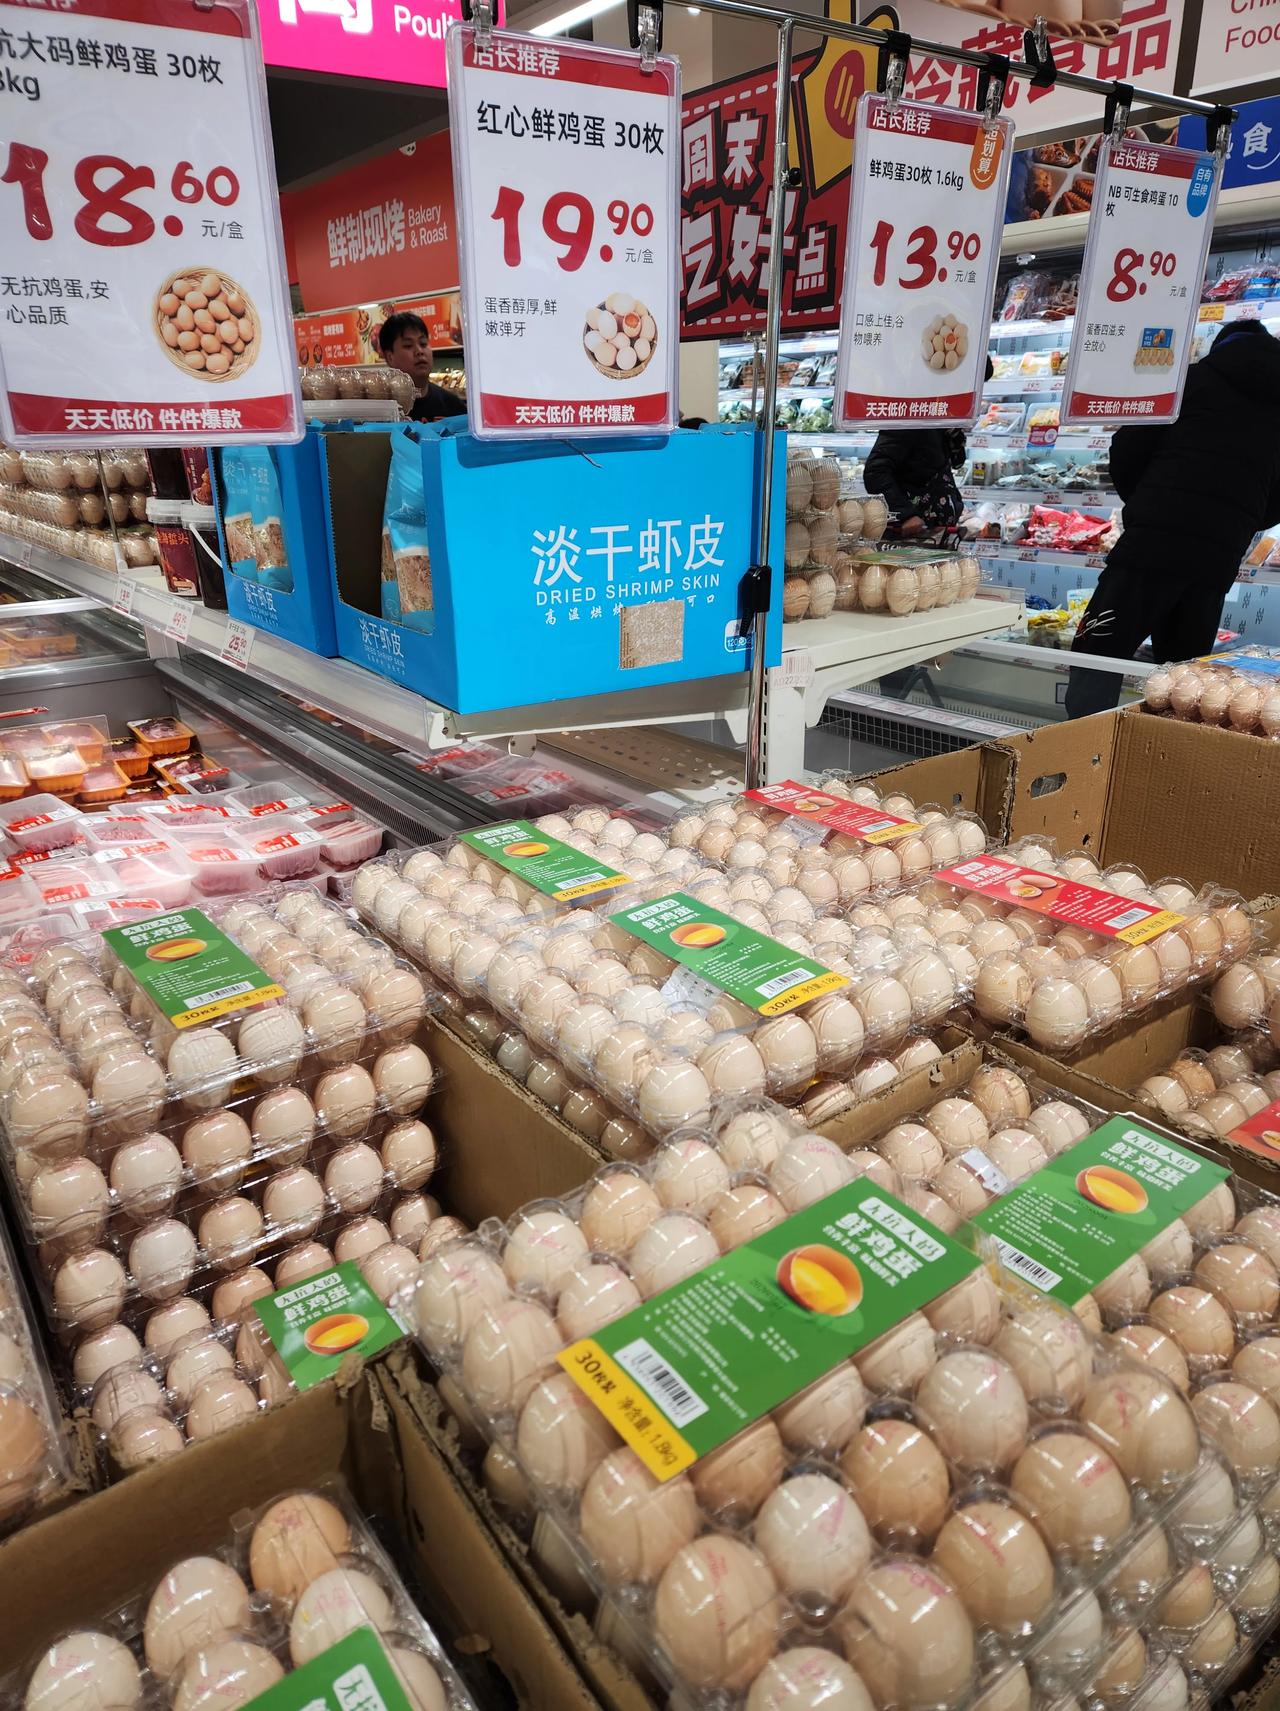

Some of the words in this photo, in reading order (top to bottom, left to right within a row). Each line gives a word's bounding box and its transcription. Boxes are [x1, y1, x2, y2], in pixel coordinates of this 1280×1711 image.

[167, 53, 224, 85] 30枚
[472, 42, 561, 77] 店长推荐
[476, 99, 607, 149] 红心鲜鸡蛋
[613, 123, 665, 155] 30枚
[872, 104, 932, 135] 店长推荐
[682, 112, 761, 193] 周末
[1112, 148, 1160, 171] 店长推荐
[869, 159, 932, 186] 鲜鸡蛋30枚
[936, 168, 964, 191] 1.6kg
[1108, 185, 1121, 198] NB
[1124, 185, 1167, 206] 可生食鸡蛋
[1168, 193, 1179, 207] 10
[408, 204, 442, 227] Bakery
[1105, 201, 1116, 217] 枚
[200, 219, 245, 240] 元/盒
[325, 198, 406, 269] 鲜制现烤
[410, 234, 418, 248] &
[419, 223, 449, 246] Roast
[625, 247, 655, 265] 元/盒
[955, 269, 977, 284] 元/盒
[6, 304, 69, 326] 心品质
[484, 321, 526, 339] 嫩弹牙
[853, 331, 882, 347] 物喂养
[64, 408, 155, 431] 天天低价
[158, 410, 242, 432] 件件爆款
[514, 405, 575, 425] 天天低价
[578, 404, 636, 425] 件件爆款
[865, 402, 907, 418] 天天低价
[908, 401, 948, 418] 件件爆款
[1087, 400, 1121, 416] 天天低价
[1122, 401, 1155, 416] 件件爆款
[529, 513, 726, 587] 淡干虾皮
[536, 586, 596, 607] DRIED
[605, 578, 674, 600] SHRIMP
[682, 573, 720, 594] SKIN
[1107, 1141, 1188, 1186] 鲜鸡蛋
[834, 1211, 925, 1280] 鲜鸡蛋
[284, 1283, 351, 1321] 鲜鸡蛋
[573, 1350, 619, 1395] 30枚装
